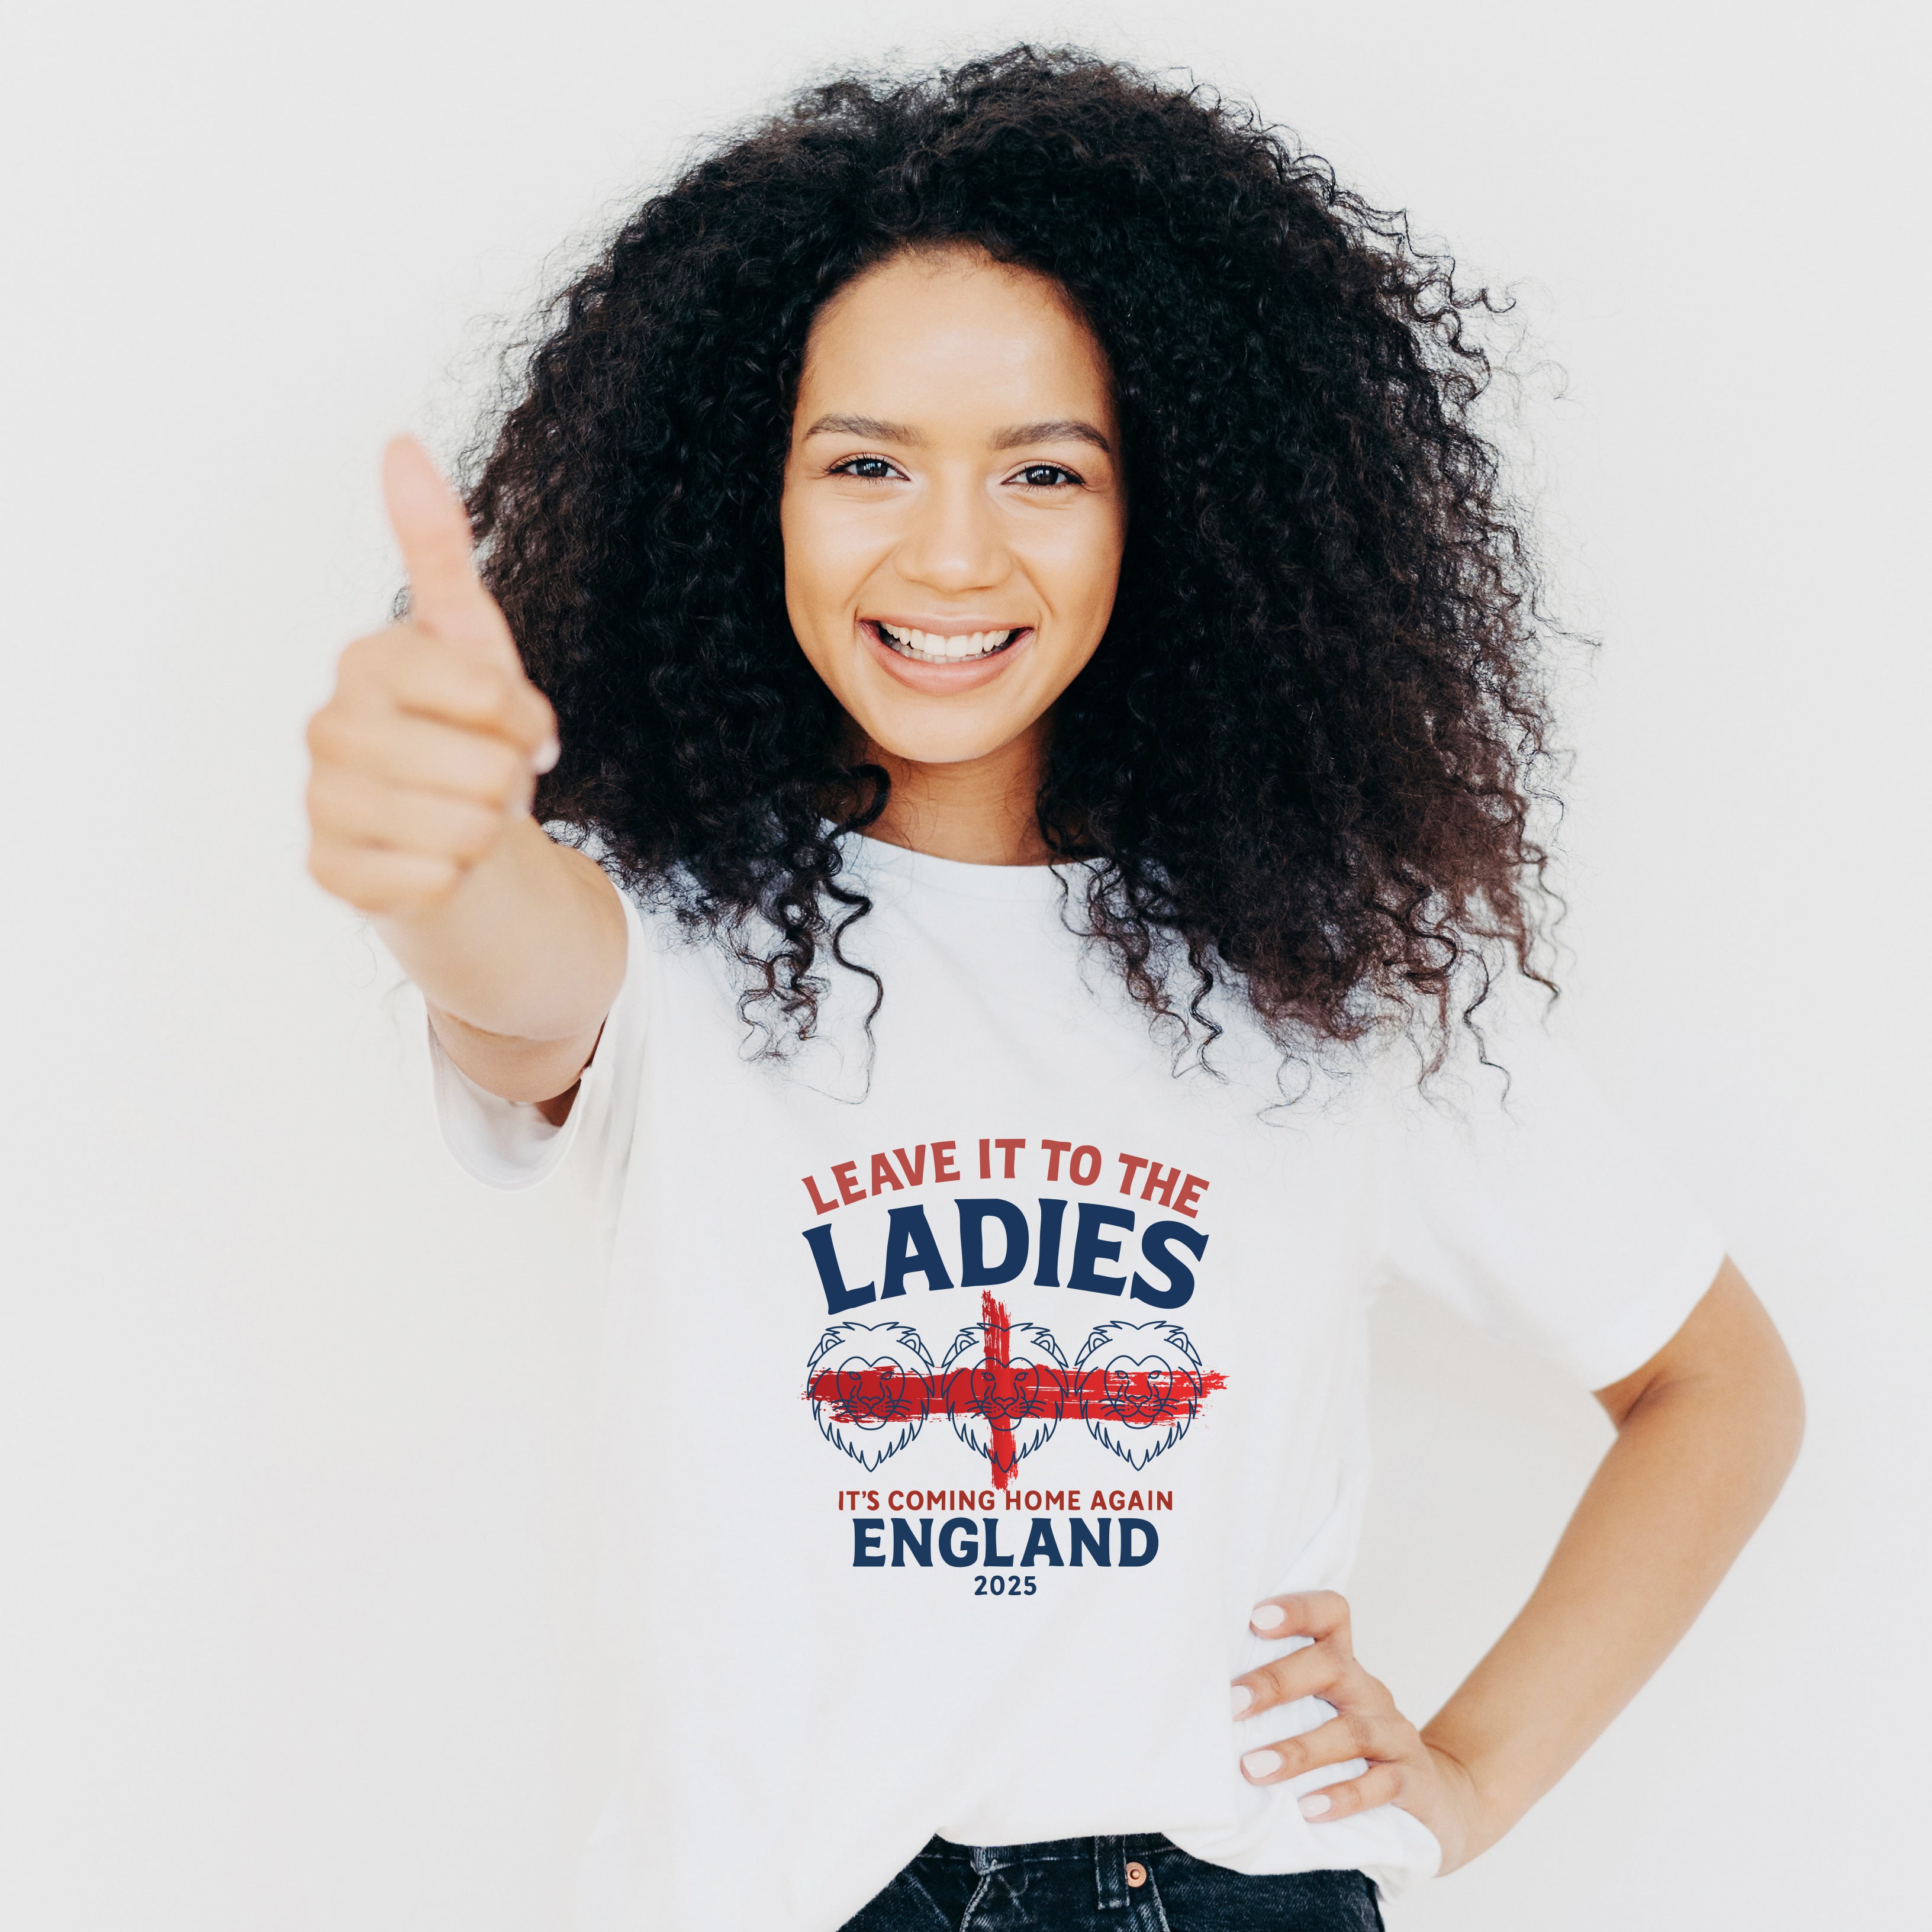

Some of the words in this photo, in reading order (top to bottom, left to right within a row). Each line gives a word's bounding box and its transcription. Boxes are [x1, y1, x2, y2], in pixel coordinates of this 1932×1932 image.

[801, 1141, 961, 1215] LEAVE
[979, 1138, 1026, 1179] IT
[1041, 1139, 1102, 1186] TO
[1118, 1152, 1210, 1219] THE
[801, 1197, 1209, 1315] LADIES
[839, 1490, 880, 1511] IT'S
[888, 1490, 995, 1511] COMING
[1005, 1490, 1081, 1511] HOME
[1090, 1490, 1173, 1511] AGAIN
[852, 1517, 1159, 1568] ENGLAND
[974, 1575, 1037, 1596] 2025
